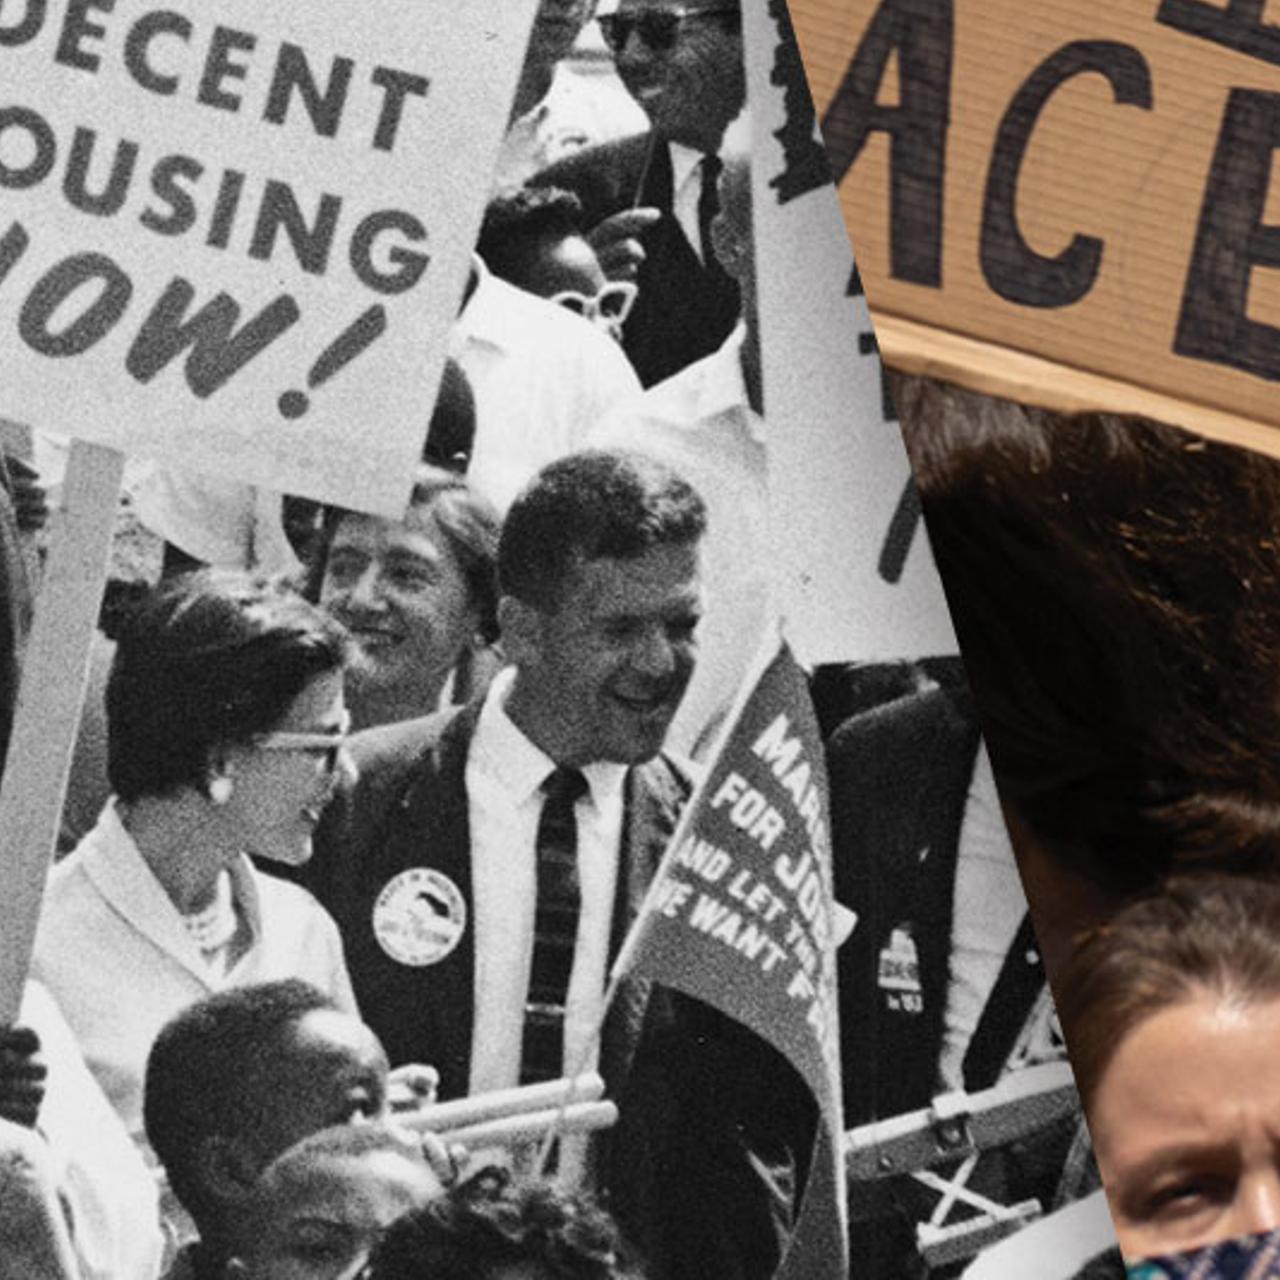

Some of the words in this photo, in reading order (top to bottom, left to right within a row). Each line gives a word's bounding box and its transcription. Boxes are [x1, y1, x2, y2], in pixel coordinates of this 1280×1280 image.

[710, 771, 787, 852] FOR
[688, 893, 789, 972] WANT
[727, 868, 788, 922] LET
